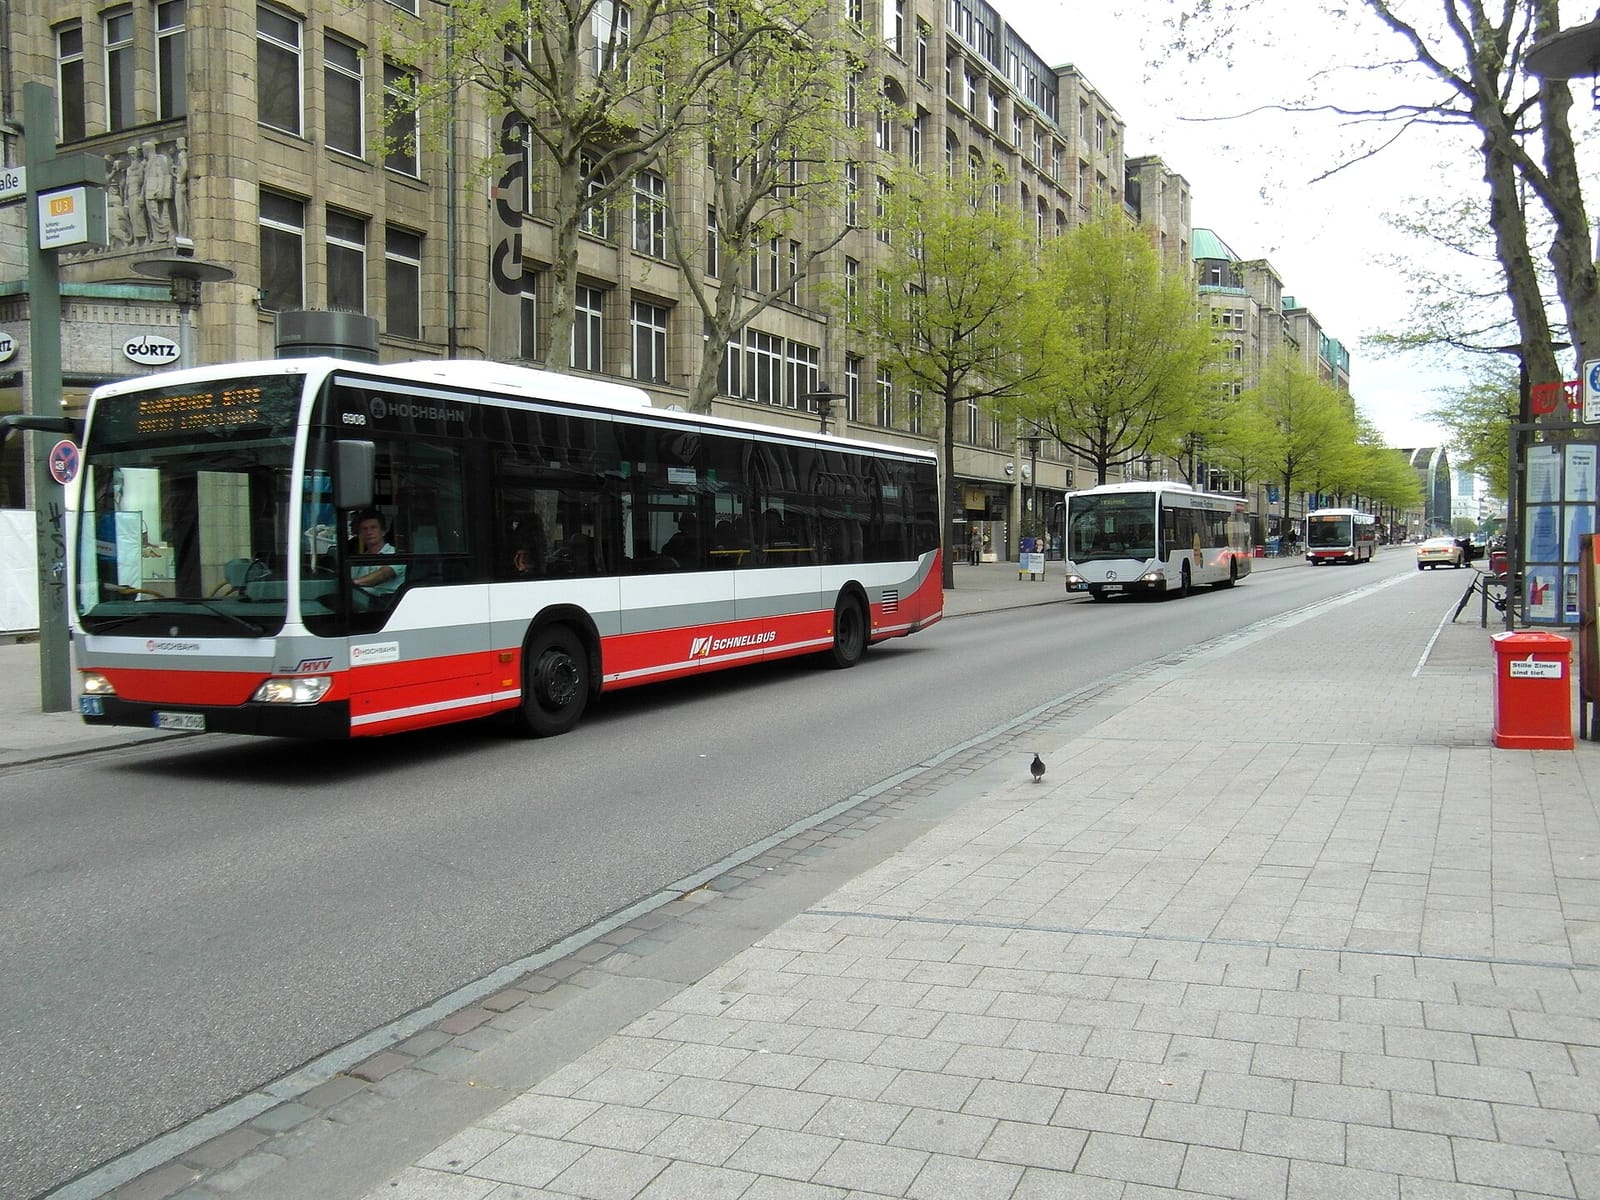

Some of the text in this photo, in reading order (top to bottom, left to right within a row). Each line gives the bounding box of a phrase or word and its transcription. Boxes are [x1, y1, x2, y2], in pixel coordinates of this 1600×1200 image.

[342, 413, 367, 426] 6908
[388, 402, 465, 423] HOCHBAHN
[712, 631, 776, 651] SCHNELLBUS
[302, 660, 332, 672] HVV
